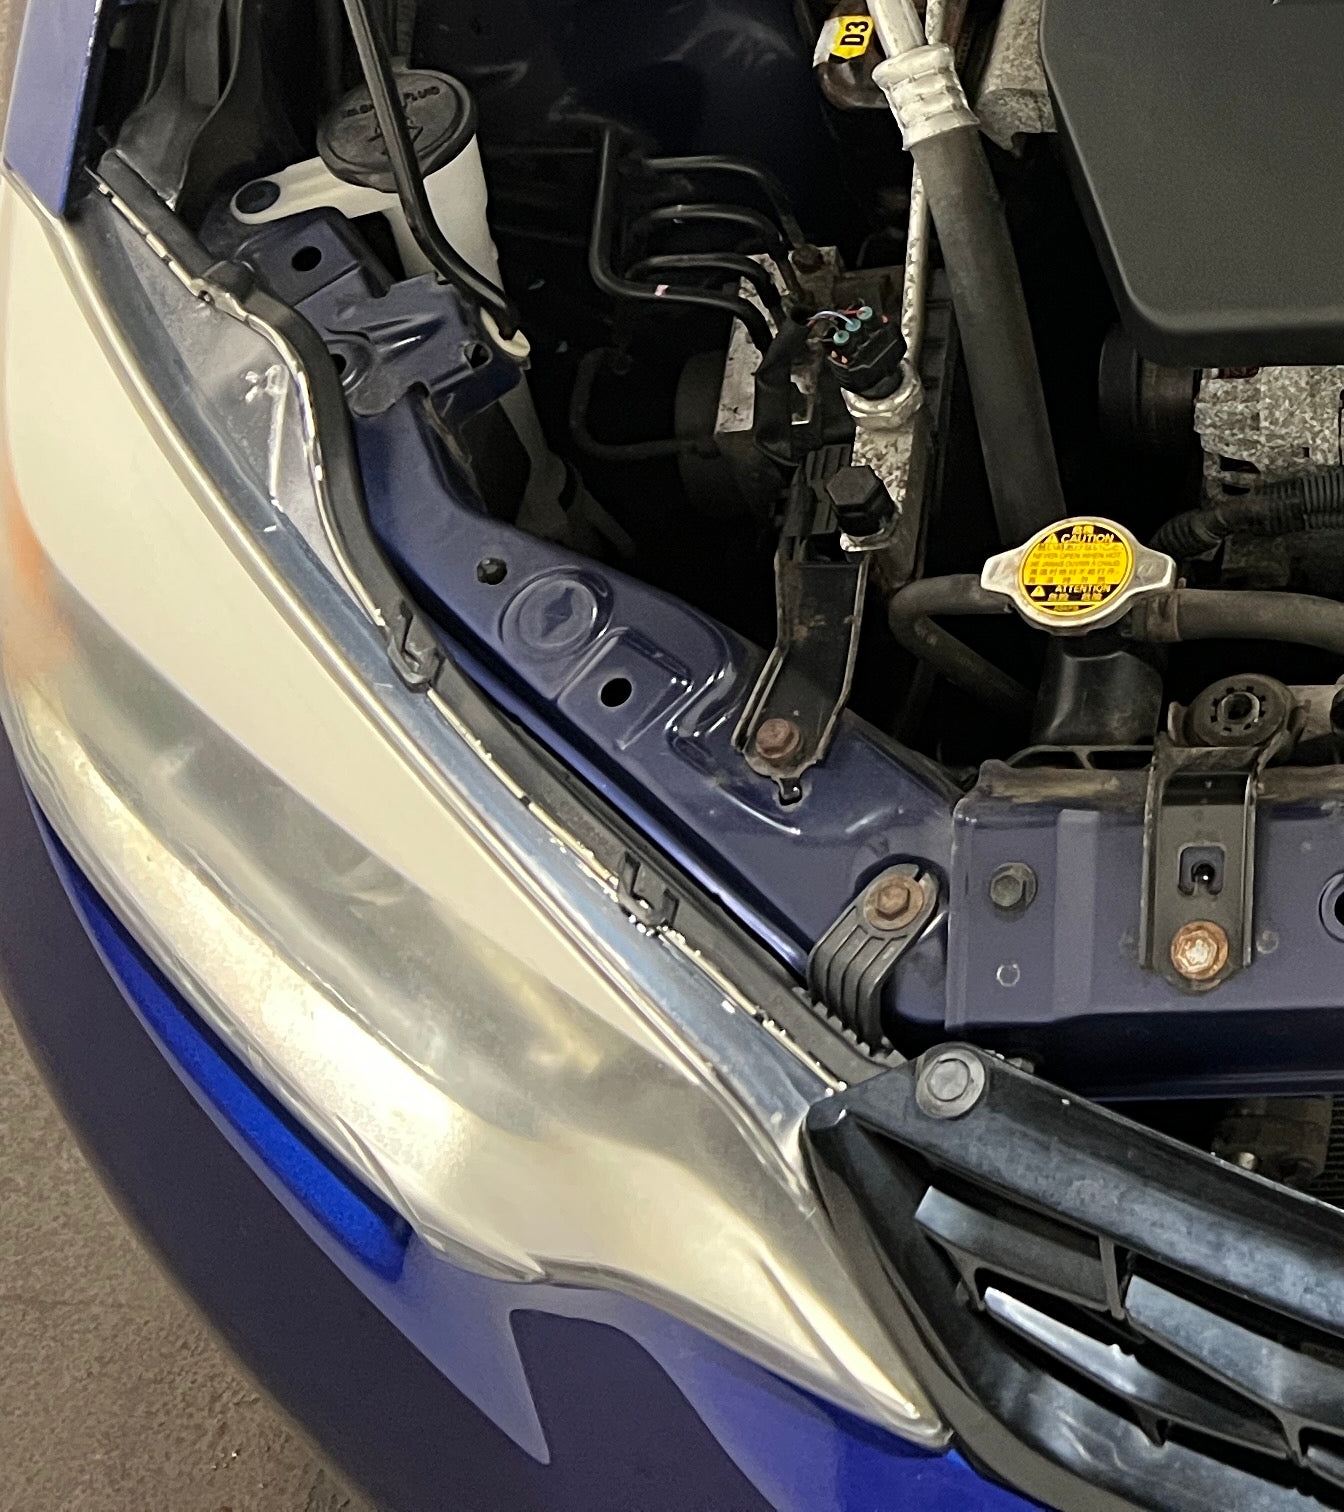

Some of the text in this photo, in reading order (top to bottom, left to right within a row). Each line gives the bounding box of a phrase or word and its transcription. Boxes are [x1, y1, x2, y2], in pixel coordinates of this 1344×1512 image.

[840, 21, 869, 46] D3
[1060, 533, 1114, 544] CAUTION
[1055, 584, 1111, 593] ATTENTION
